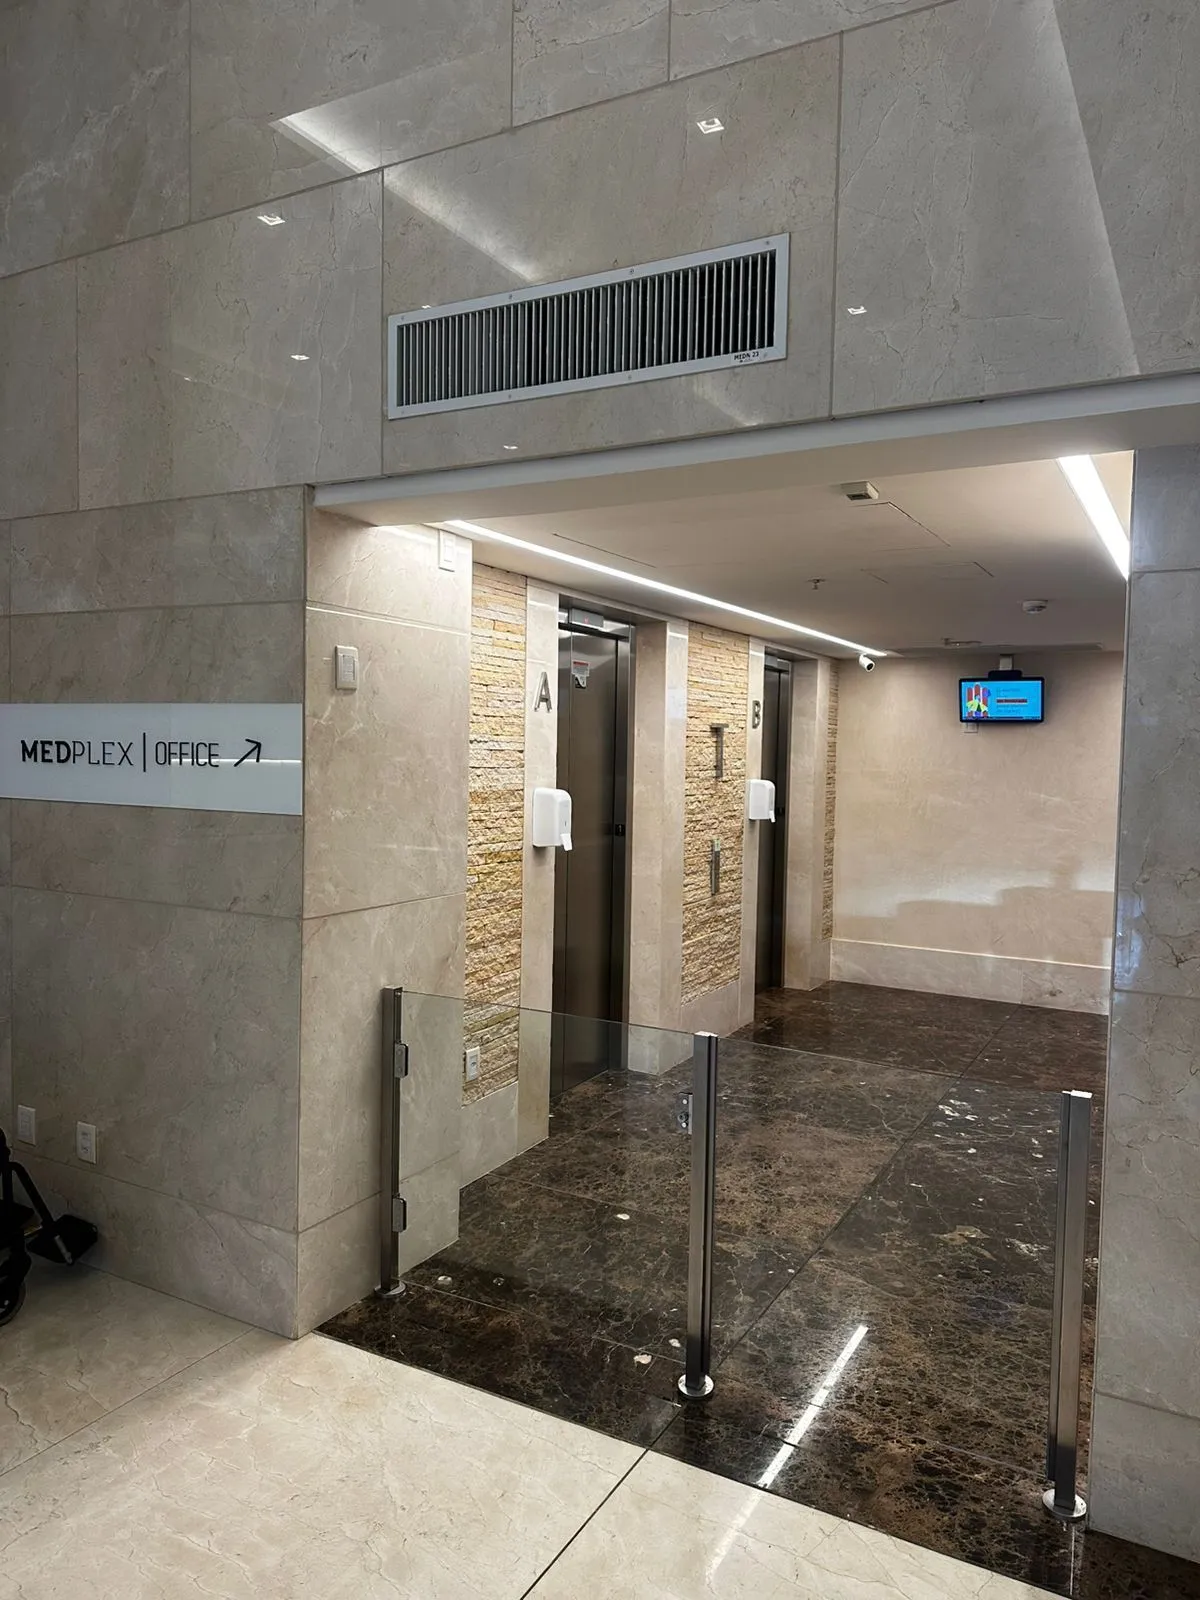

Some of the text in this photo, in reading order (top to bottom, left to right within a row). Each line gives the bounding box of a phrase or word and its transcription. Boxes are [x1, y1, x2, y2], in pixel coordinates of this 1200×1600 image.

[534, 672, 552, 713] A
[751, 700, 762, 729] B
[20, 740, 220, 768] MEDPLEX OFFICE
